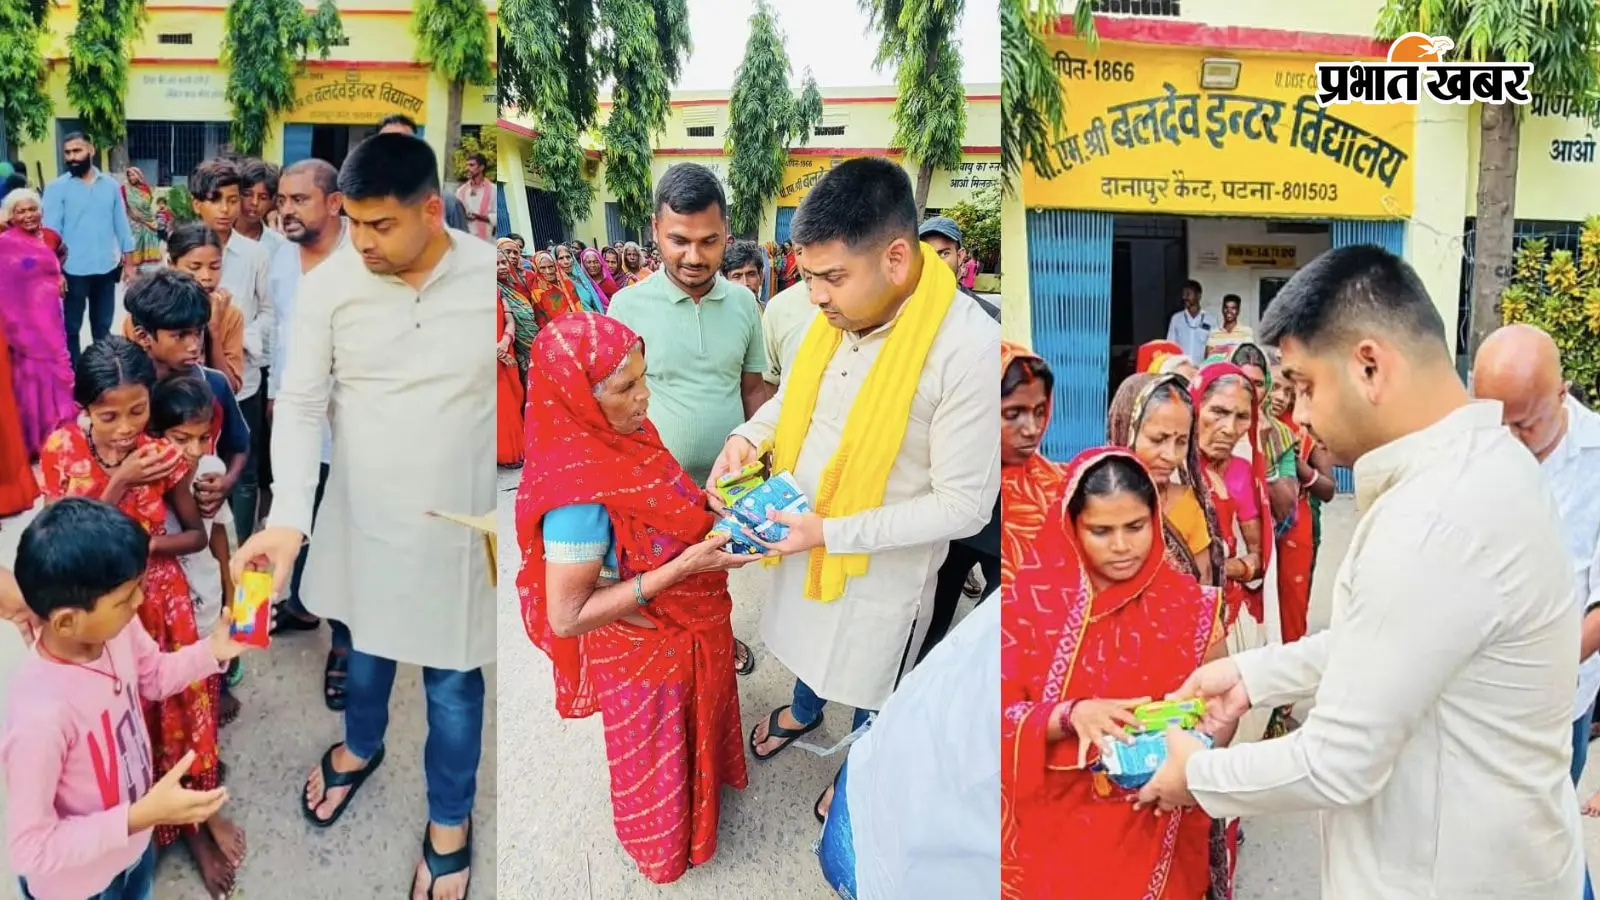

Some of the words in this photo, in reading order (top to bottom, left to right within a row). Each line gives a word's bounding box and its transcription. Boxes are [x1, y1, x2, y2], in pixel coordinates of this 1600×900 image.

[1107, 82, 1201, 149] बलदेव
[1205, 92, 1286, 149] इन्टर
[1290, 95, 1409, 188] विद्यालय
[1549, 133, 1597, 162] आओ
[1101, 176, 1169, 204] दानापुर
